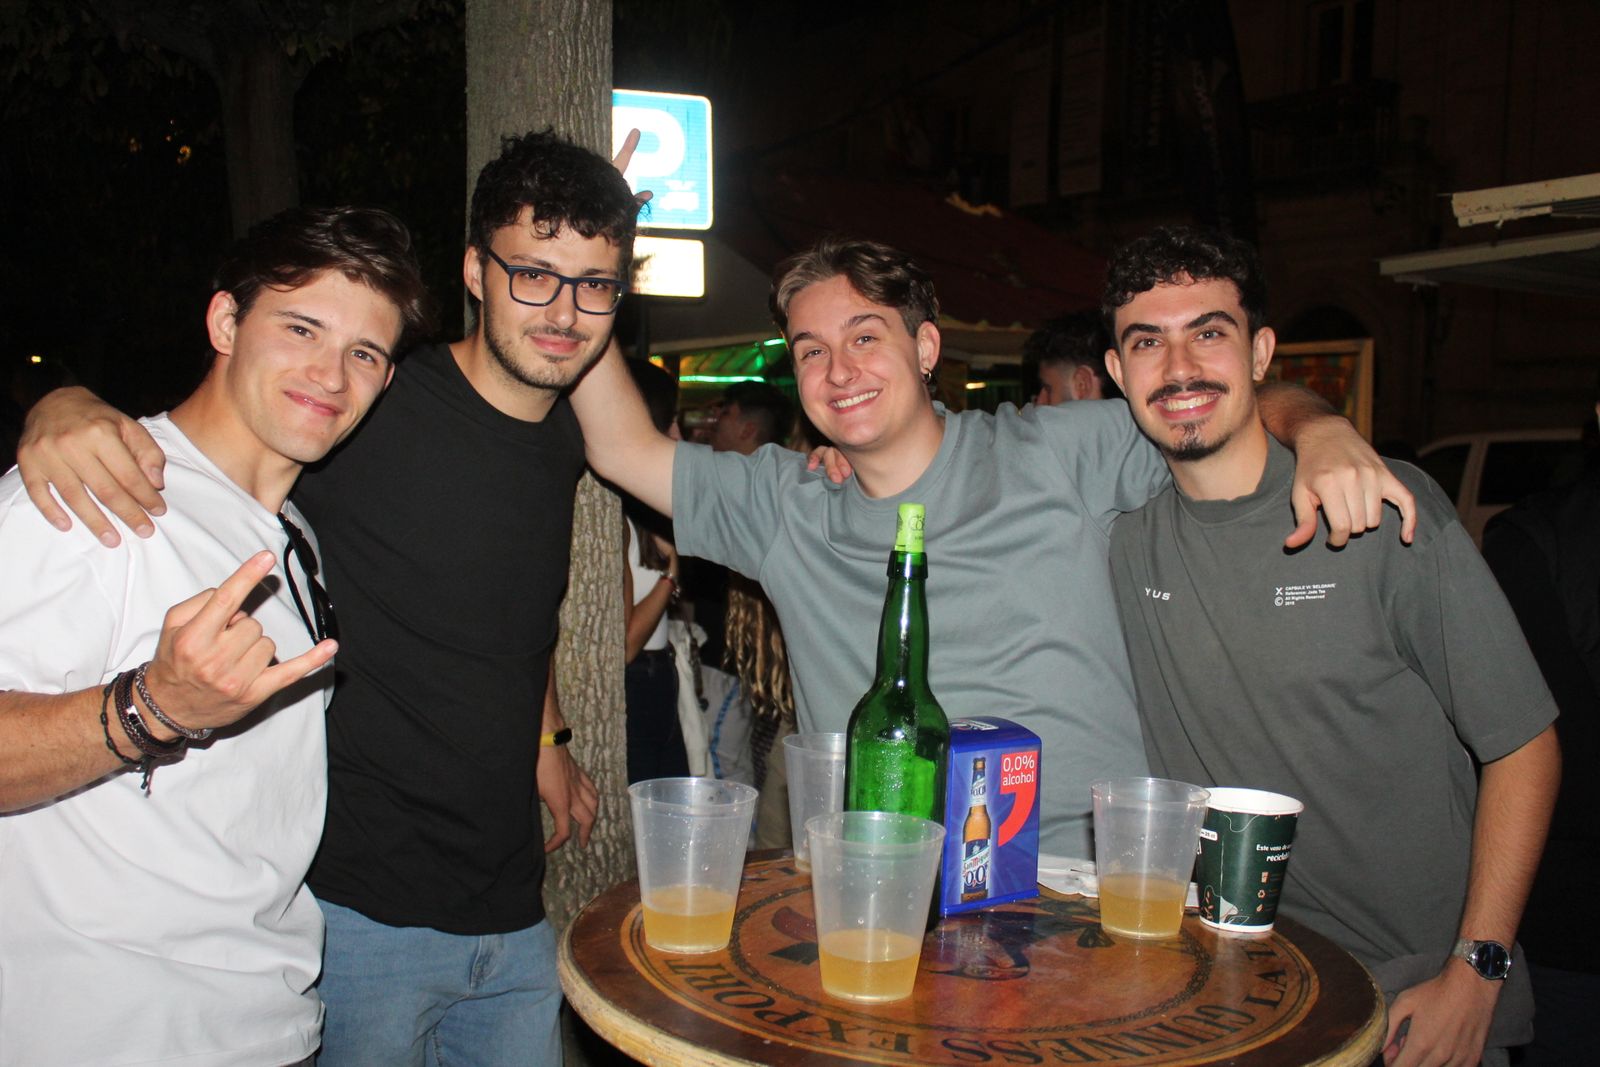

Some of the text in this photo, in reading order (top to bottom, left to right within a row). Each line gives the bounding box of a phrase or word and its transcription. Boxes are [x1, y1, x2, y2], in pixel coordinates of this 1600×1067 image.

[612, 106, 685, 196] P
[1145, 587, 1171, 601] YUS
[1003, 755, 1035, 773] 0,0%
[1003, 771, 1034, 786] alcohol
[1256, 843, 1269, 852] Este
[663, 958, 1256, 1065] GUINNESS EXPORT
